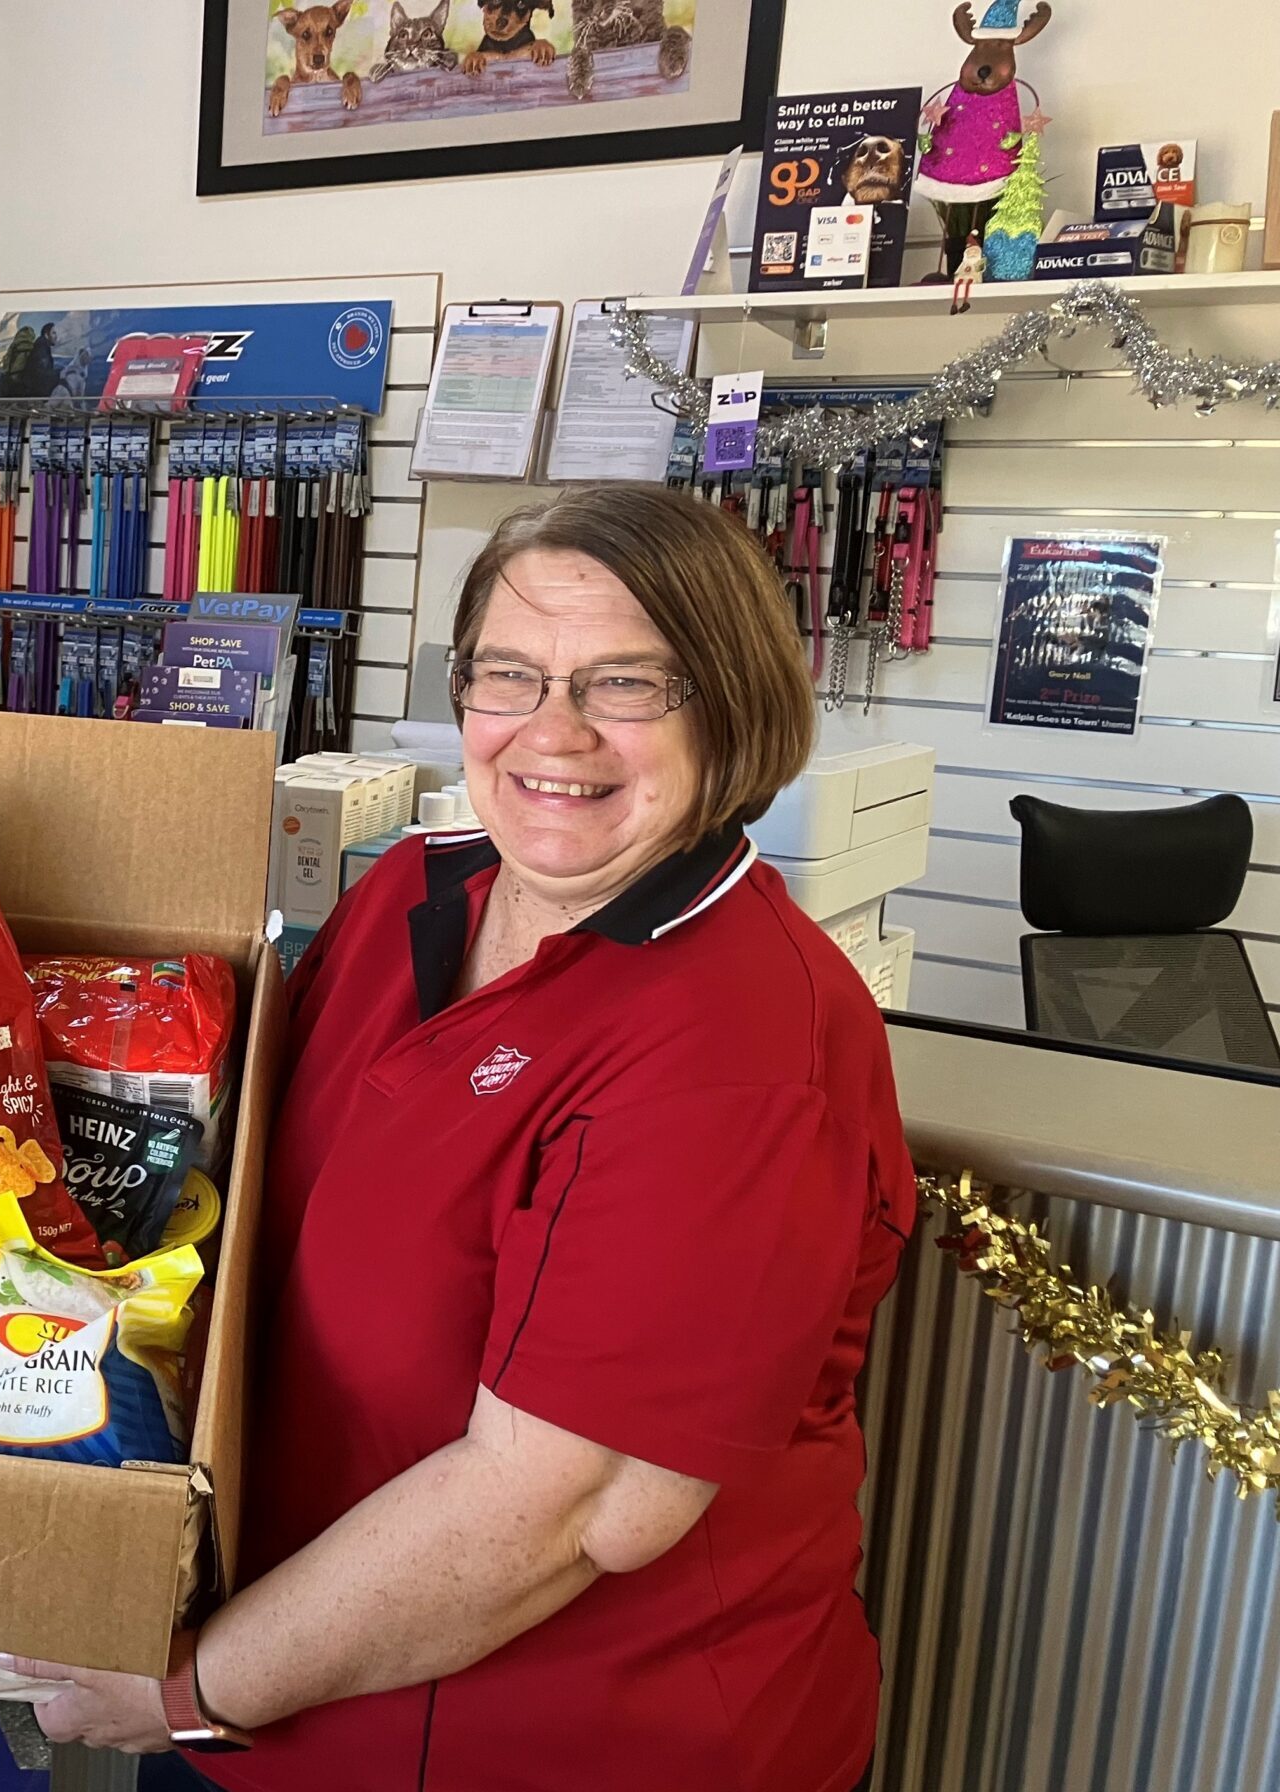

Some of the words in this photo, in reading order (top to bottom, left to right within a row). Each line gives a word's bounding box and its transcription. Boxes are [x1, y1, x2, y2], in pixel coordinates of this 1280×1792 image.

[777, 103, 811, 117] Sniff
[814, 103, 837, 115] out
[840, 104, 849, 113] a
[852, 99, 898, 112] better
[777, 118, 805, 131] way
[808, 117, 823, 128] to
[826, 114, 865, 127] claim
[774, 138, 794, 146] Claim
[795, 137, 814, 145] while
[815, 136, 829, 145] you
[789, 144, 803, 152] and
[804, 144, 817, 152] pay
[797, 188, 821, 197] GAP
[817, 216, 838, 225] VISA
[1066, 223, 1113, 232] ADVANCE
[1083, 232, 1104, 241] TEST
[1143, 230, 1174, 248] ADVANCE
[1035, 257, 1084, 270] ADVANCE
[205, 373, 230, 385] gear!
[717, 388, 757, 406] zip
[776, 392, 790, 400] The
[792, 391, 824, 400] world's
[826, 391, 857, 400] coolest
[13, 598, 31, 606] world's
[138, 603, 180, 613] rogz
[198, 598, 290, 623] VetPay
[190, 636, 214, 646] SHOP
[220, 638, 242, 648] SAVE
[193, 654, 234, 669] PetPA
[1048, 671, 1070, 680] Gary
[1064, 690, 1102, 704] Prize
[169, 701, 195, 711] SHOP
[196, 703, 204, 712] &
[206, 703, 230, 713] SAVE
[1037, 714, 1059, 723] Goes
[1101, 720, 1132, 729] theme
[297, 855, 321, 868] DENTAL
[303, 868, 314, 879] GEL
[491, 1053, 514, 1064] THE
[477, 1072, 512, 1087] ARMY
[2, 1095, 34, 1115] SPICY
[110, 1104, 135, 1115] FRESH
[150, 1112, 168, 1122] FOIL
[69, 1114, 137, 1152] HEINZ
[80, 1191, 105, 1207] day
[38, 1225, 58, 1238] 150g
[59, 1223, 73, 1235] NET
[23, 1349, 97, 1372] GRAIN
[35, 1378, 73, 1394] RICE
[14, 1404, 22, 1414] &
[25, 1404, 53, 1417] Fluffy
